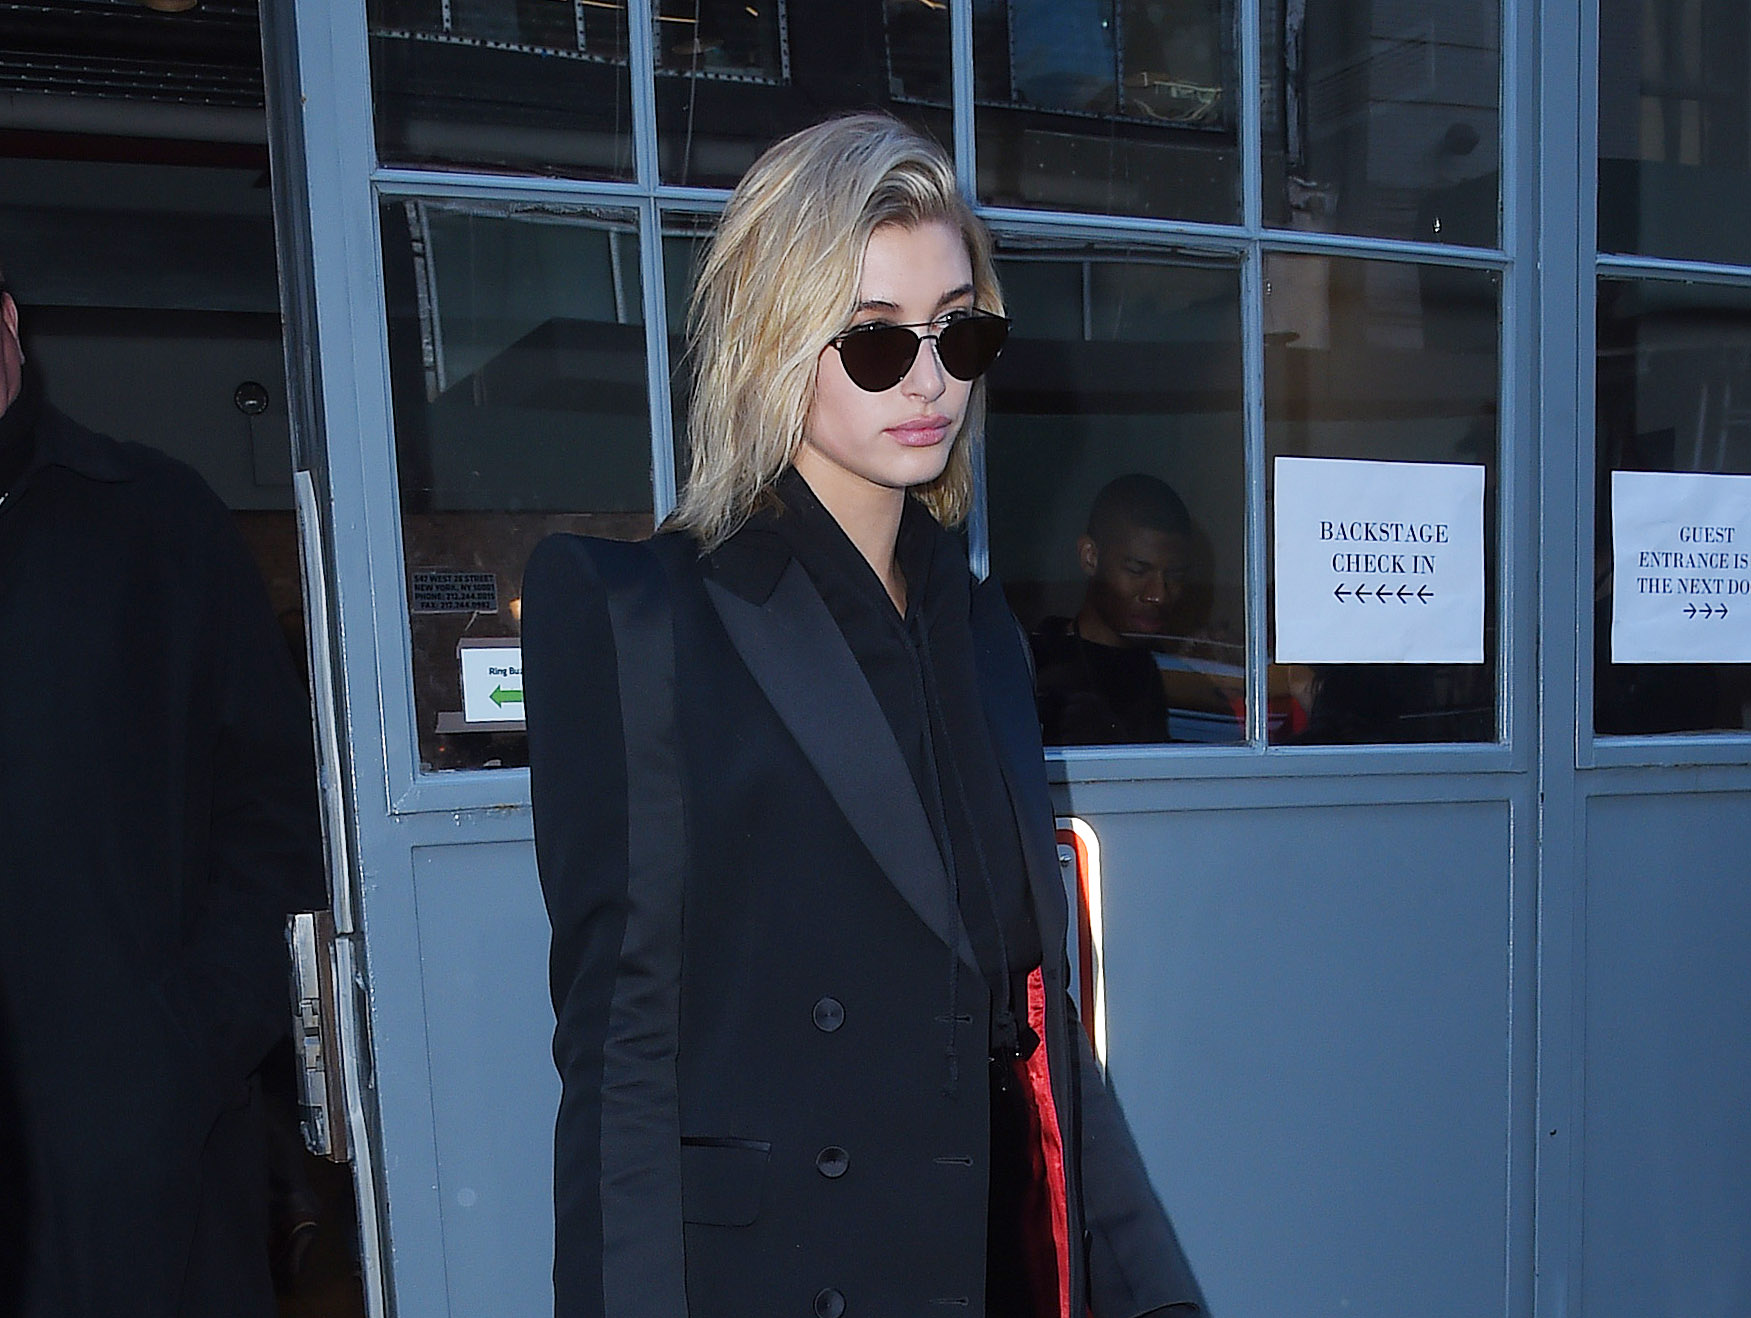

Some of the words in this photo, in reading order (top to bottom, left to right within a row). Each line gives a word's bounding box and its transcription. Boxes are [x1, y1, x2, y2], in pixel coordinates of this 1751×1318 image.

[1320, 521, 1449, 543] BACKSTAGE
[1680, 526, 1735, 543] GUEST
[1332, 553, 1406, 573] CHECK
[1412, 555, 1436, 574] IN
[1639, 551, 1729, 569] ENTRANCE
[1733, 553, 1749, 569] IS
[429, 575, 452, 583] WEST
[464, 575, 494, 583] STREET
[1637, 577, 1673, 594] THE
[1677, 578, 1724, 594] NEXT
[1728, 579, 1751, 595] DO
[414, 592, 445, 600] PHONE:
[489, 667, 507, 677] Ring
[509, 667, 523, 675] Bu
